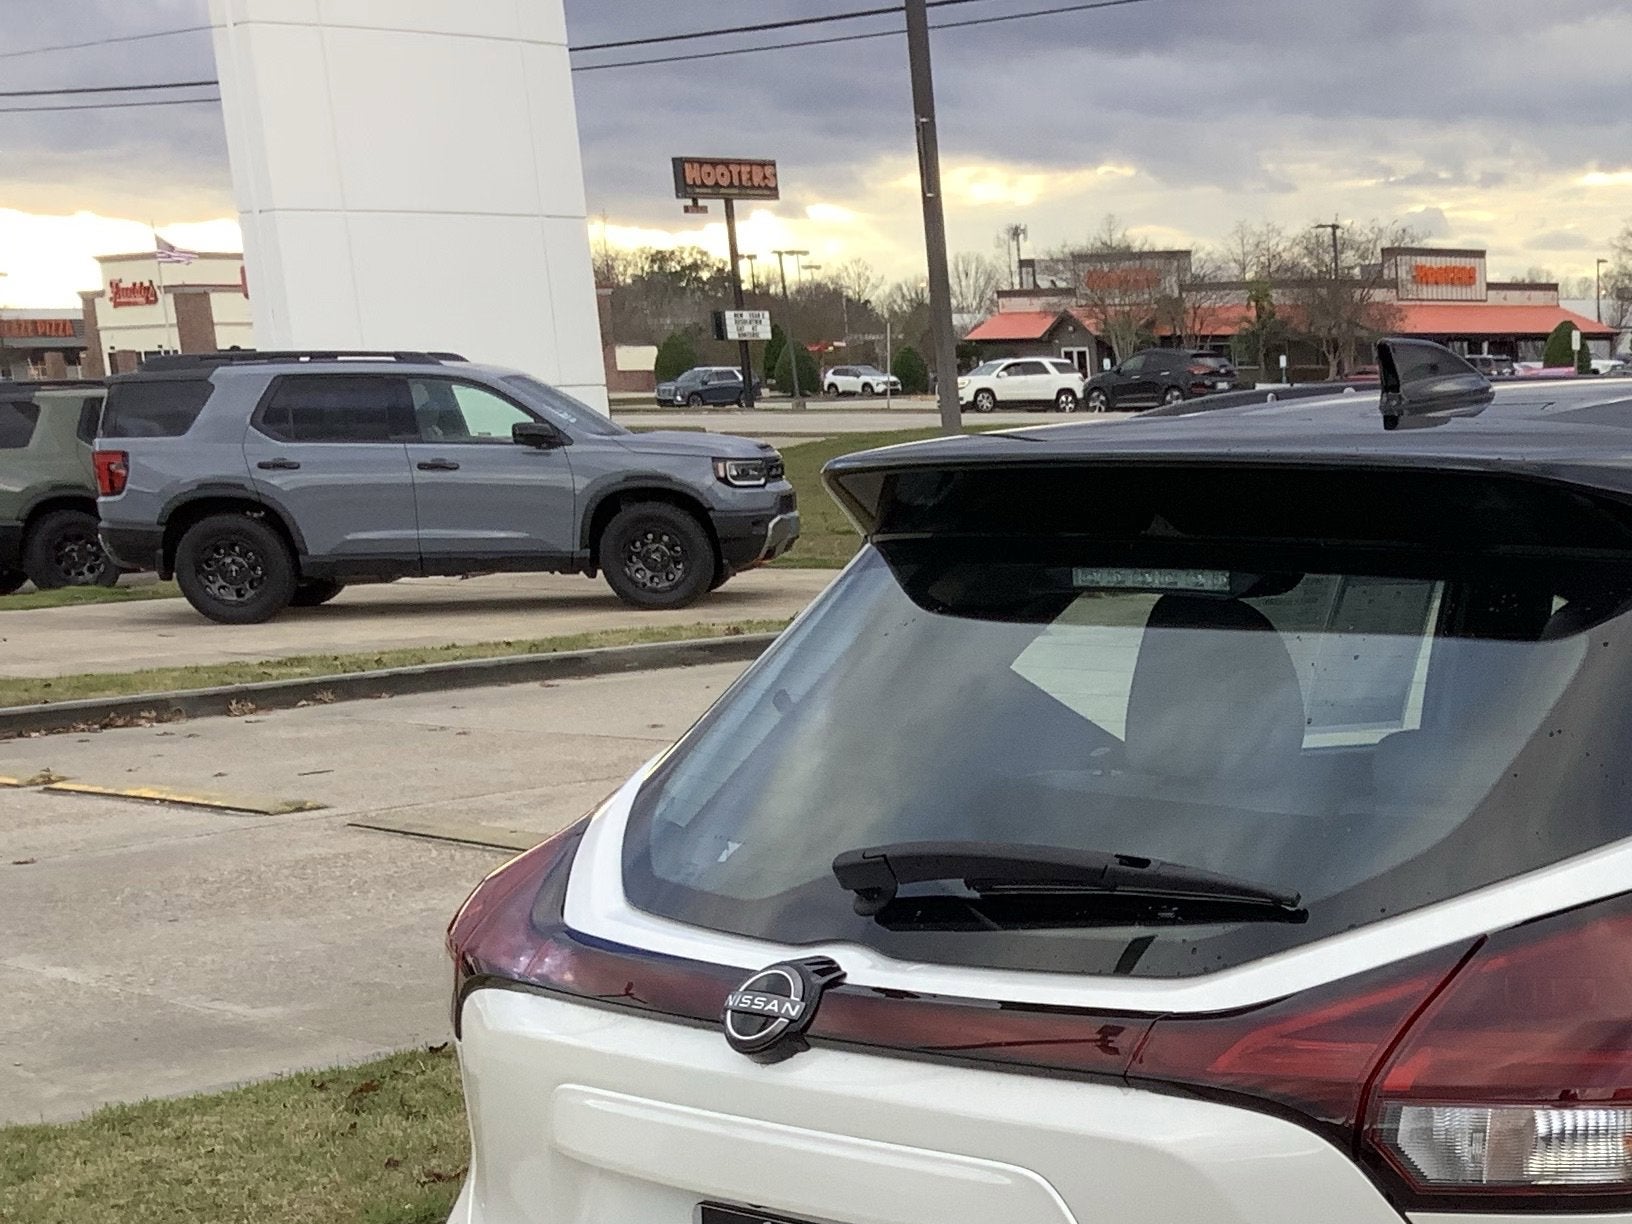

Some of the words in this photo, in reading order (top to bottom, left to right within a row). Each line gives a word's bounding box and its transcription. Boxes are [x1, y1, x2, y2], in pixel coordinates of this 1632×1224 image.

[684, 162, 777, 188] HOOTERS
[36, 319, 74, 338] PIZZA
[724, 993, 801, 1017] NISSAN
